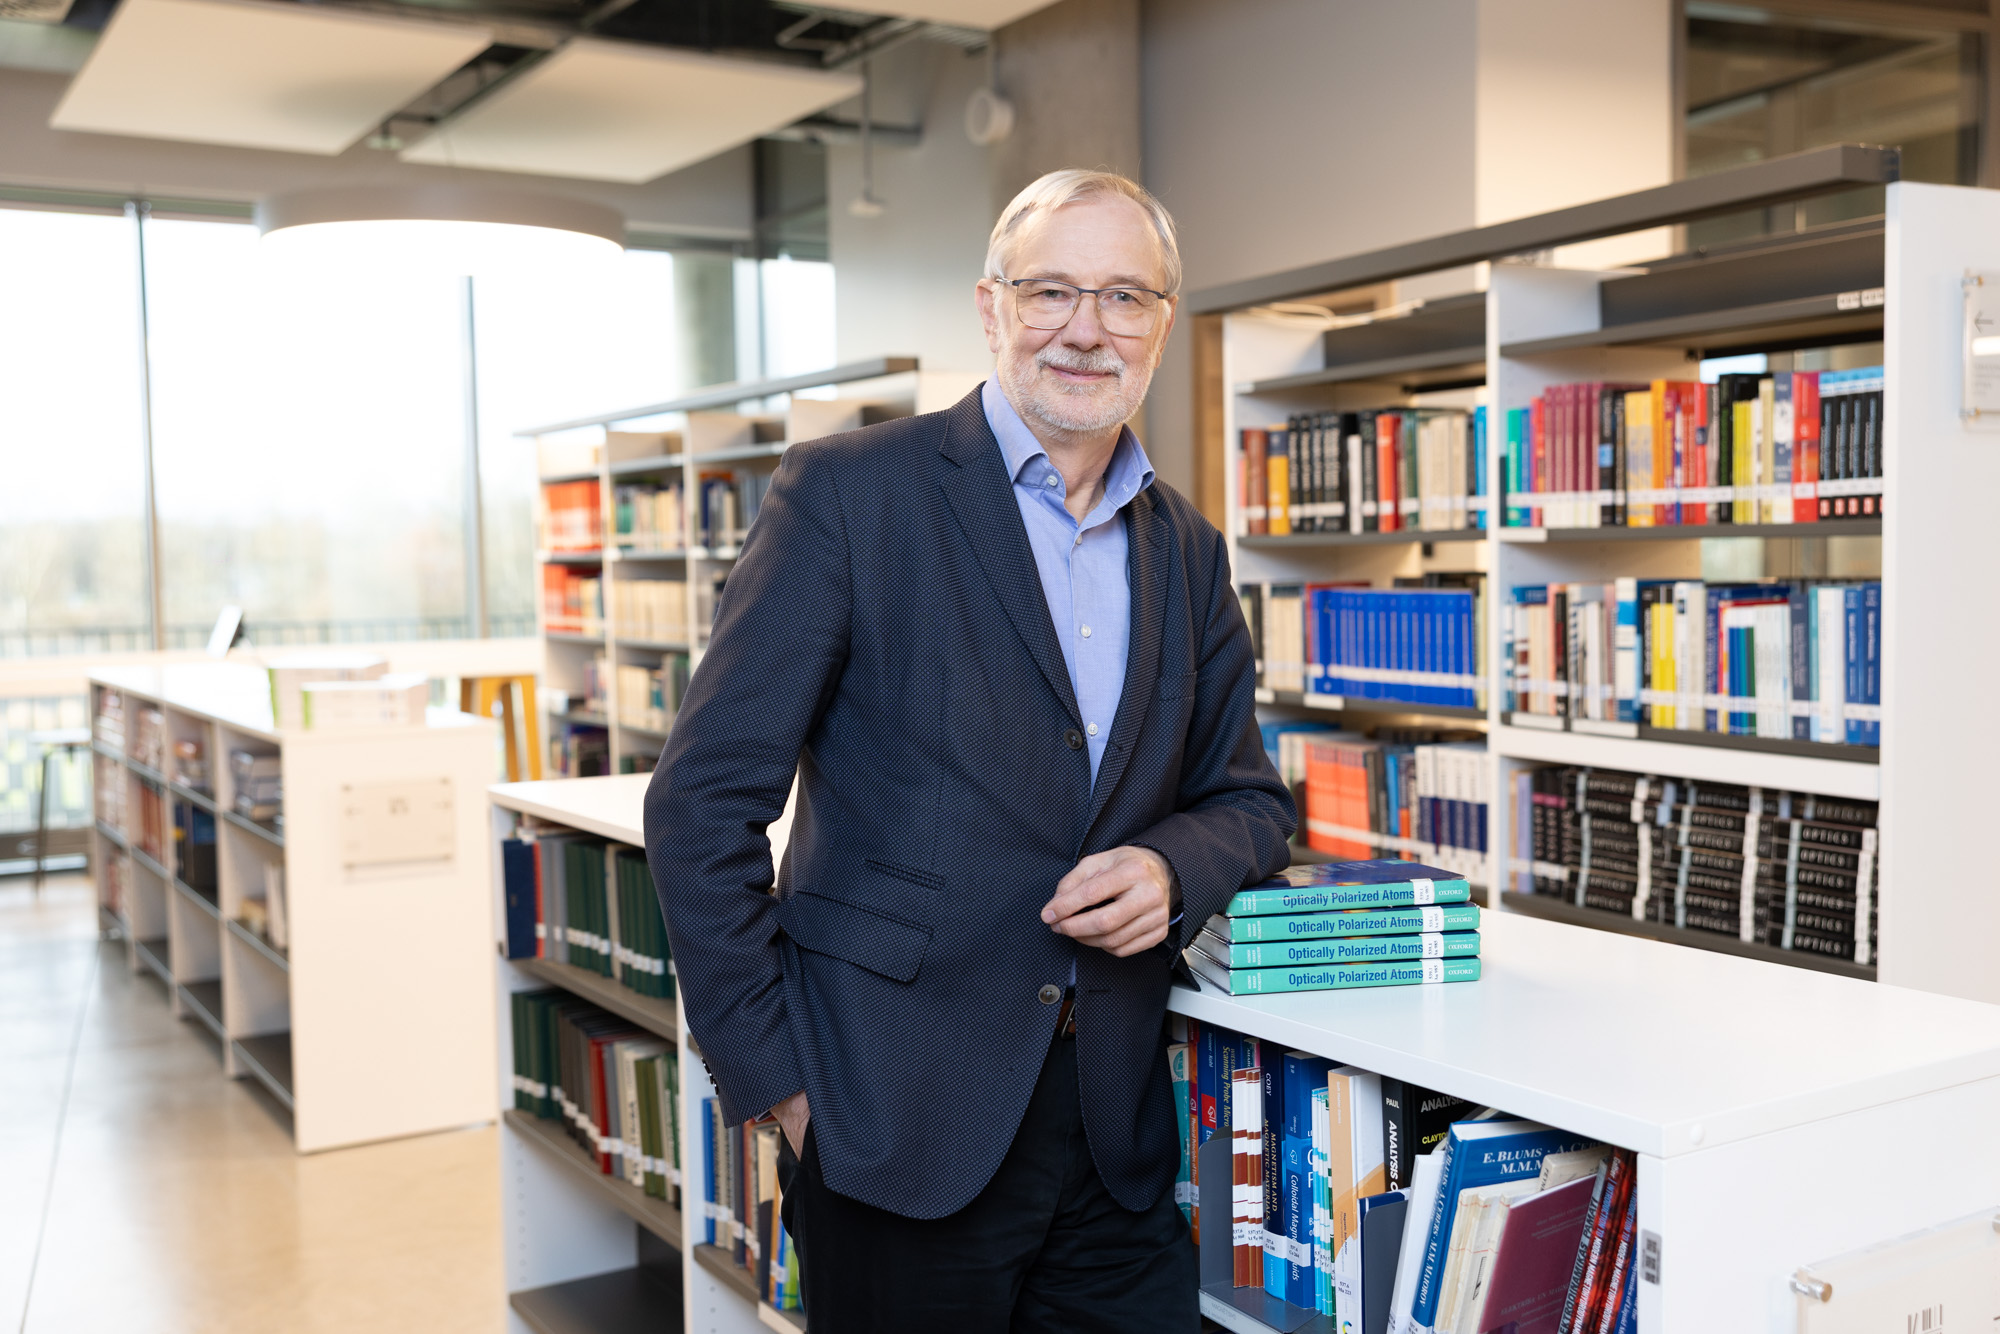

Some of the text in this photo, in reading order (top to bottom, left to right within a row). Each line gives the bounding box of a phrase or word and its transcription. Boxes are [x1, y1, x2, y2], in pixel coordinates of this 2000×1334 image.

[1802, 827, 1849, 845] OPTICS
[1800, 849, 1846, 867] OPTICS
[1798, 870, 1844, 888] OPTICS
[1283, 889, 1415, 908] Optically Polarized Atoms
[1798, 892, 1844, 909] OPTICS
[1288, 917, 1423, 935] Optically Polarized Atoms
[1797, 913, 1843, 931] OPTICS
[1288, 943, 1423, 960] Optically Polarized Atoms
[1795, 935, 1841, 953] OPTICS
[1288, 969, 1423, 987] Optically Polarized Atoms
[1222, 1046, 1231, 1081] Scanning
[1223, 1081, 1231, 1104] Probe
[1386, 1097, 1400, 1109] PAUL
[1388, 1120, 1399, 1180] ANALYSIS
[1270, 1132, 1278, 1190] MAGNETISM
[1290, 1174, 1299, 1211] Colloidal
[1598, 1181, 1616, 1228] INTRODUCTION
[1595, 1227, 1604, 1238] TO
[1621, 1230, 1631, 1242] TO
[1589, 1235, 1603, 1264] MODERN
[1615, 1239, 1629, 1269] MODERN
[1419, 1266, 1434, 1308] MAIOROV
